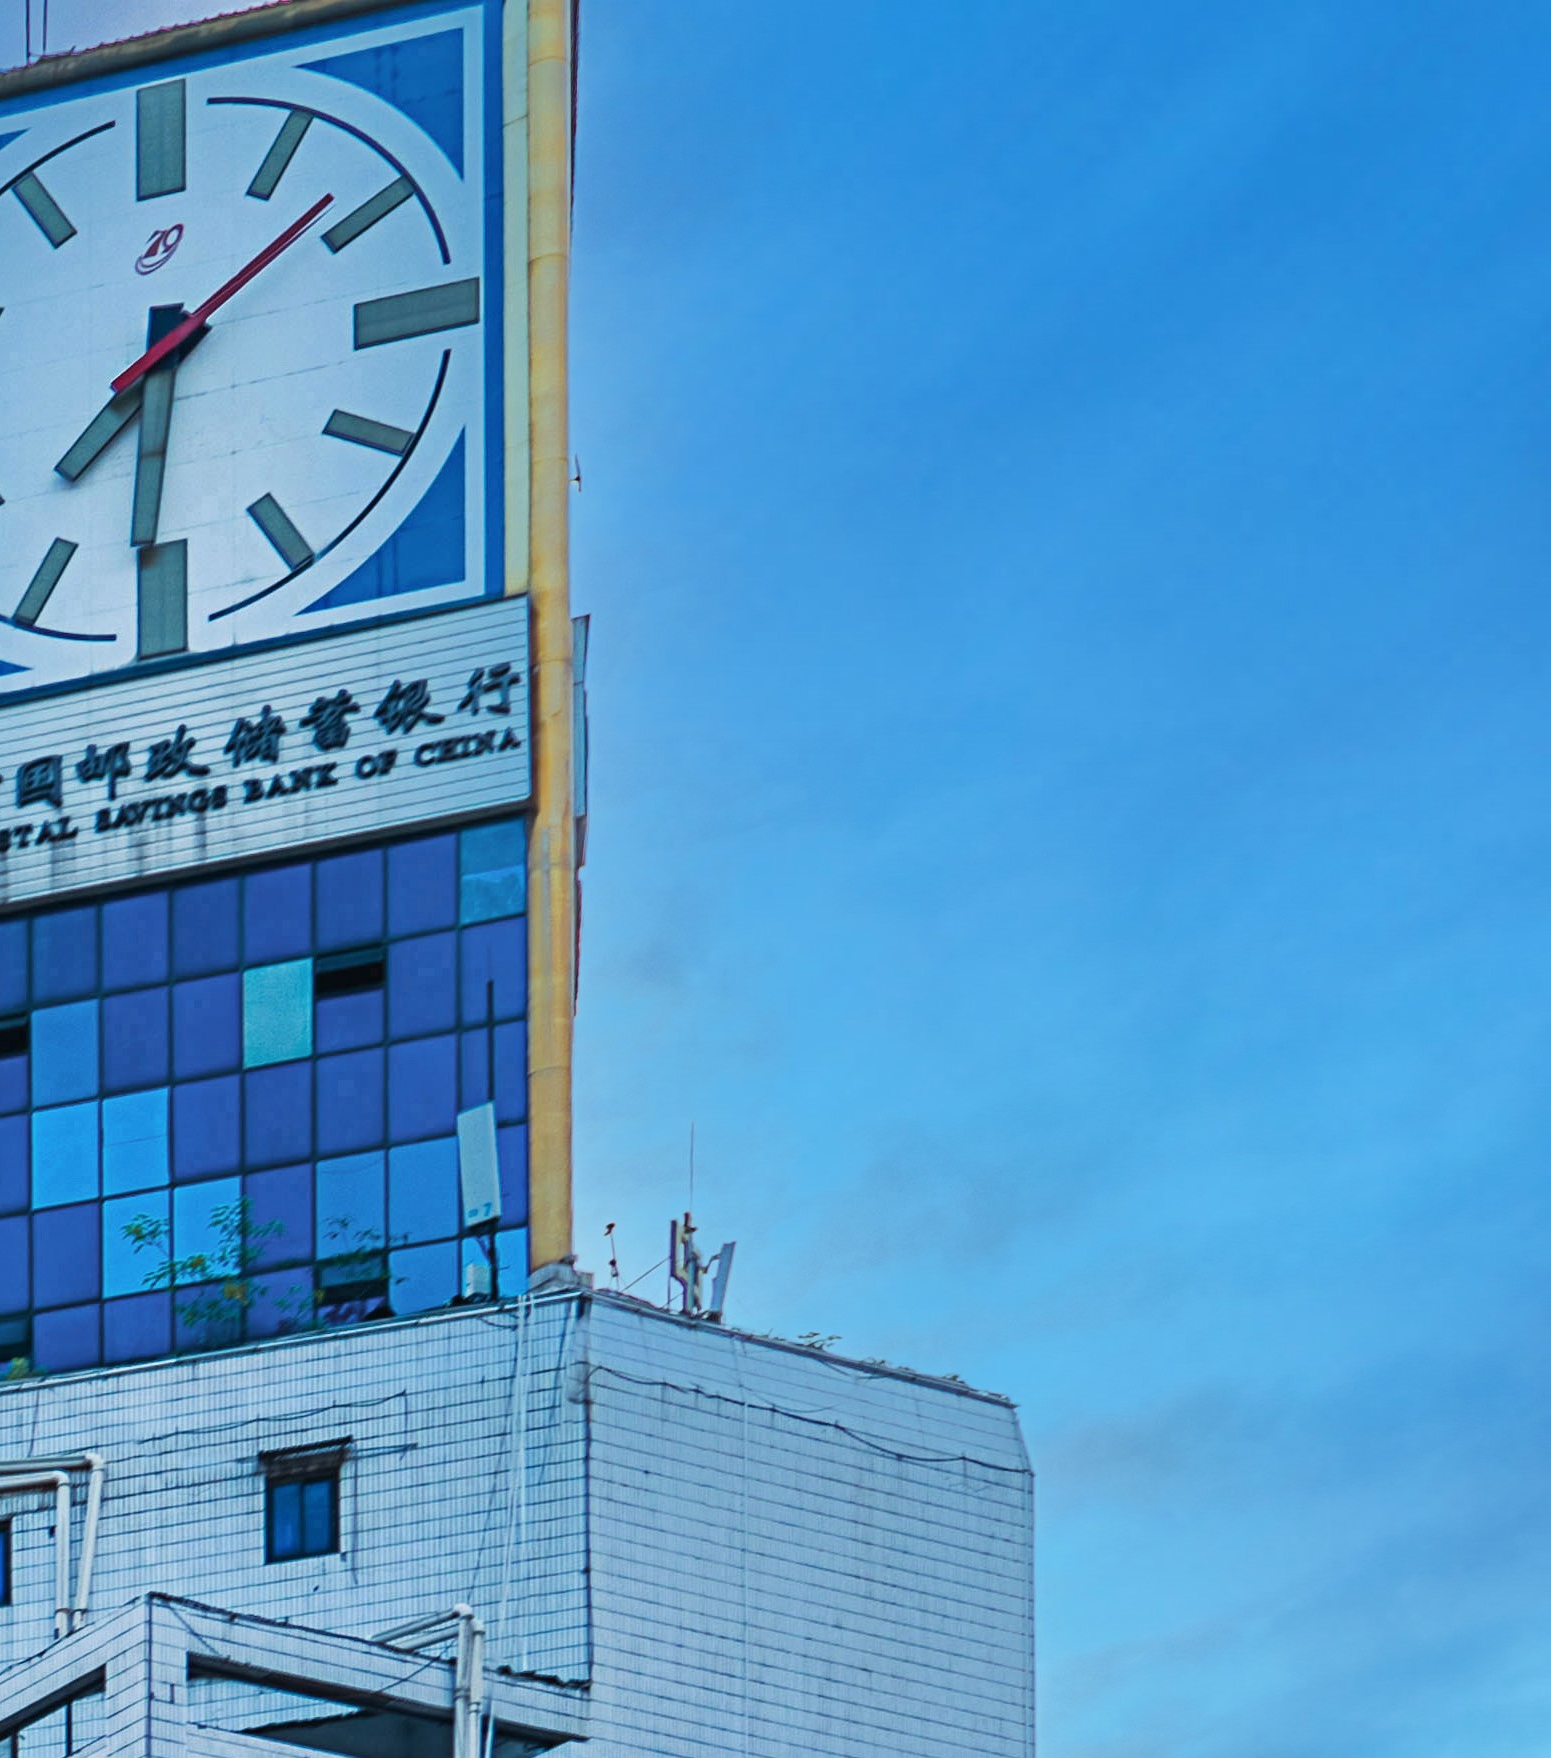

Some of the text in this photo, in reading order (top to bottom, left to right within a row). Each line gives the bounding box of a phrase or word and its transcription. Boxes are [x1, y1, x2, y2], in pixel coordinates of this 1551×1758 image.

[95, 785, 227, 832] SAVINGS
[243, 762, 338, 804] BANK
[355, 750, 398, 779] OF
[414, 727, 521, 767] CHINA
